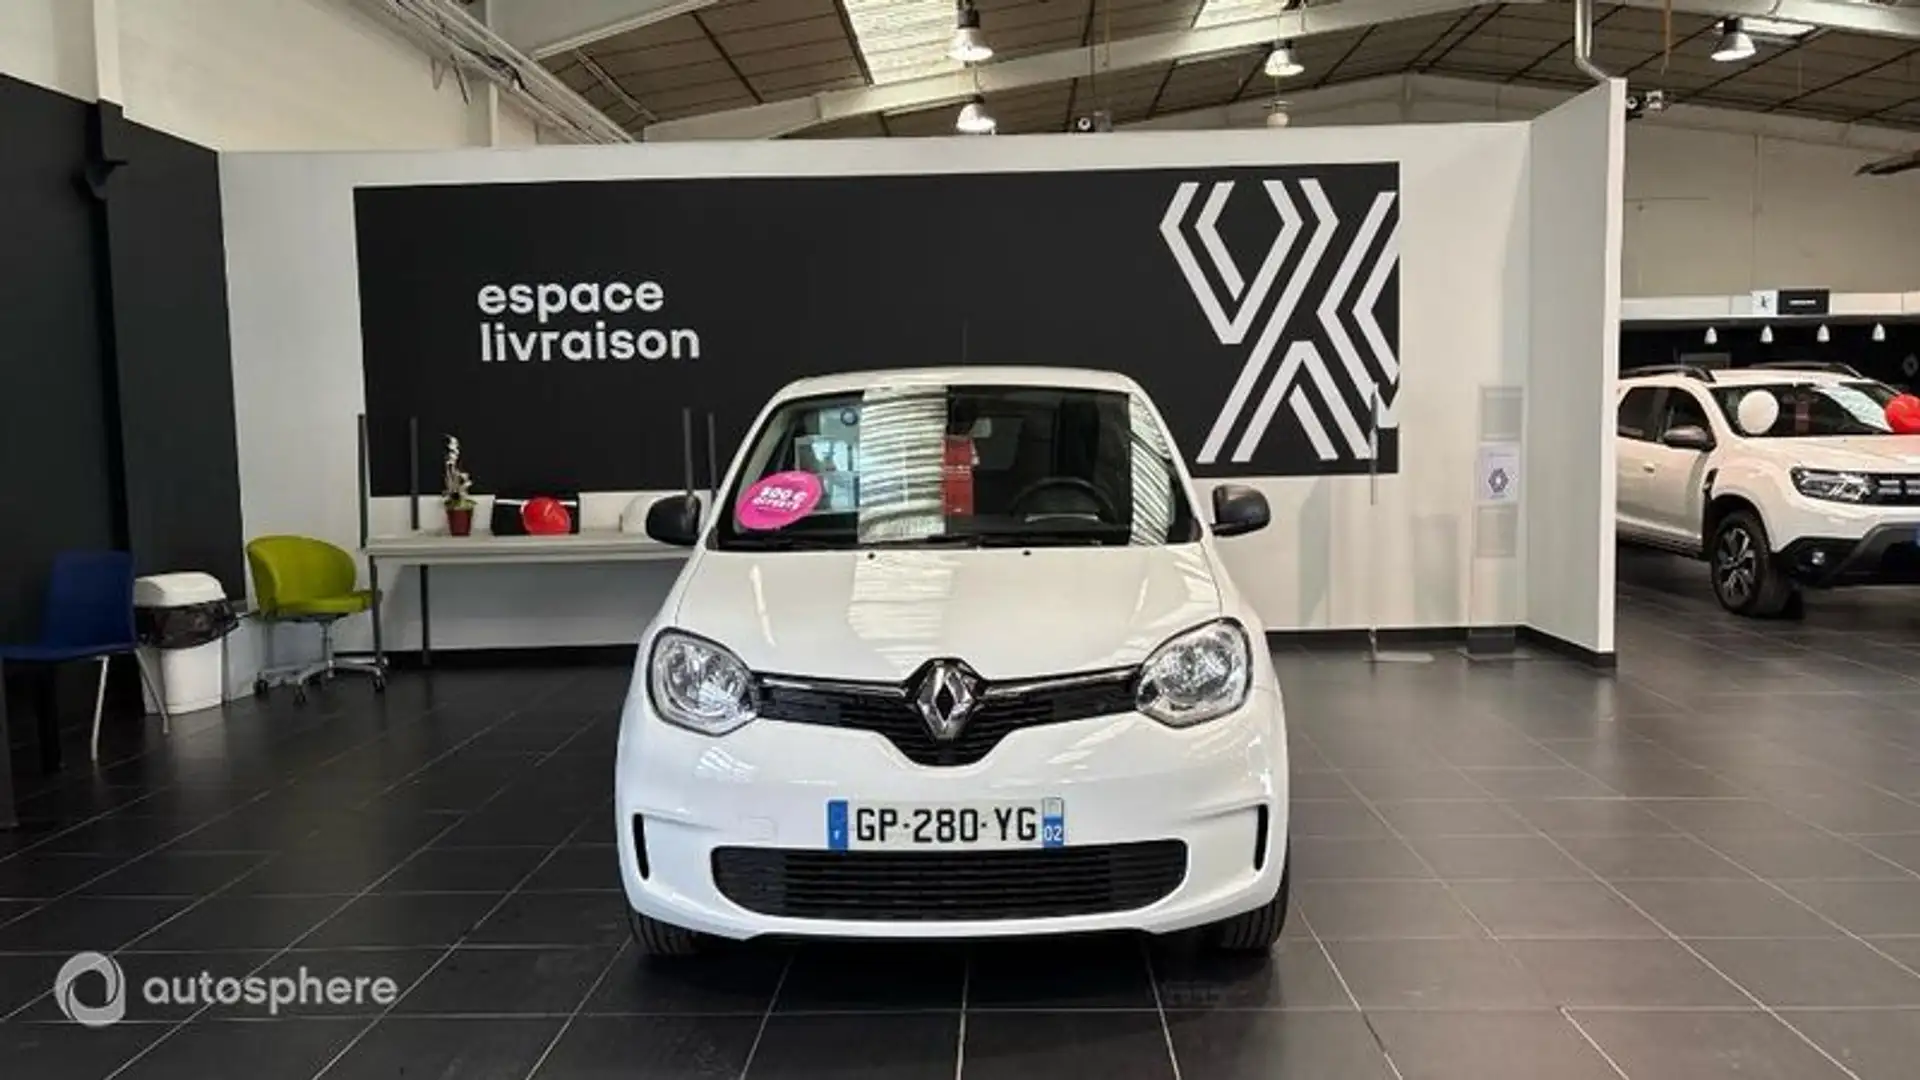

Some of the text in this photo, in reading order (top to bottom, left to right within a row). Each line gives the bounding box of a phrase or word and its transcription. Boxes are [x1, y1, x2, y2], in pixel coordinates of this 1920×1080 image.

[477, 280, 664, 324] espace
[480, 320, 700, 362] livraison
[856, 807, 1037, 843] GP-280-YG
[1043, 824, 1062, 841] 02
